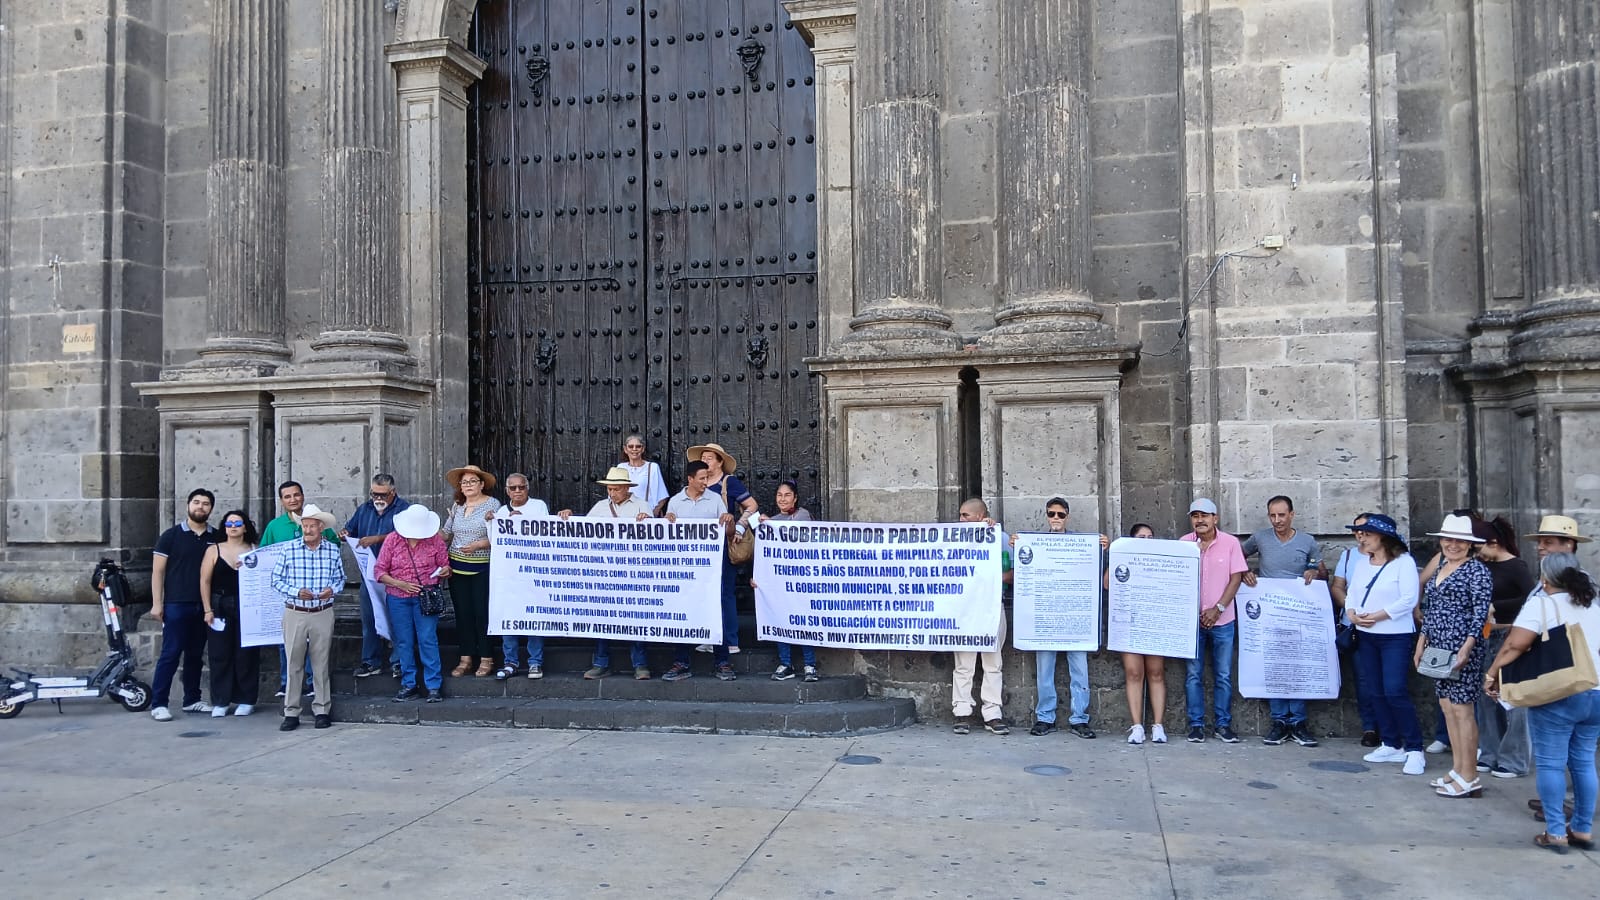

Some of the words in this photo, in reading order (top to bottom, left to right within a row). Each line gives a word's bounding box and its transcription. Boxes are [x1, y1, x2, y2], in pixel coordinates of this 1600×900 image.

[498, 519, 518, 535] SR.
[521, 520, 614, 539] GOBERNADOR
[619, 523, 664, 540] PABLO
[669, 523, 718, 540] LEMUS
[758, 524, 778, 542] SR.
[780, 525, 884, 544] GOBERNADOR
[889, 527, 938, 544] PABLO
[943, 527, 996, 544] LEMUS
[504, 539, 541, 548] SOLICITAMOS
[541, 540, 550, 548] LEA
[557, 541, 580, 550] ANALICE
[581, 542, 588, 550] LO
[591, 543, 629, 551] INCUMPLIBLE
[633, 544, 643, 552] DEL
[644, 544, 676, 552] CONVENIO
[678, 544, 689, 552] QUE
[514, 552, 549, 561] REGULARIZAR
[553, 554, 578, 563] NUESTRA
[606, 556, 613, 564] YA
[615, 557, 627, 565] QUE
[628, 557, 640, 565] NOS
[641, 558, 671, 566] CONDENA
[672, 558, 680, 566] DE
[681, 558, 694, 566] POR
[695, 558, 710, 566] VIDA
[763, 547, 771, 557] EN
[773, 548, 782, 558] LA
[784, 549, 819, 560] COLONIA
[822, 549, 830, 560] EL
[833, 549, 877, 561] PEDREGAL
[882, 550, 894, 560] DE
[896, 549, 945, 561] MILPILLAS,
[947, 549, 989, 561] ZAPOPAN
[533, 567, 549, 575] TENER
[551, 567, 581, 576] SERVICIOS
[609, 570, 627, 578] COMO
[638, 571, 654, 579] AGUA
[773, 565, 811, 577] TENEMOS
[813, 566, 819, 577] 5
[822, 564, 845, 577] AÑOS
[848, 566, 907, 579] BATALLANDO,
[909, 567, 928, 577] POR
[931, 567, 940, 577] EL
[942, 566, 967, 577] AGUA
[969, 566, 975, 577] Y
[542, 580, 552, 588] QUE
[562, 581, 583, 589] SOMOS
[594, 583, 650, 592] FRACCIONAMIENTO
[653, 585, 679, 593] PRIVADO
[786, 581, 794, 592] EL
[796, 582, 840, 593] GOBIERNO
[898, 584, 910, 594] SE
[912, 584, 924, 594] HA
[927, 584, 963, 594] NEGADO
[561, 595, 588, 603] INMENSA
[638, 598, 663, 606] VECINOS
[810, 599, 882, 611] ROTUNDAMENTE
[885, 601, 891, 611] A
[893, 601, 934, 612] CUMPLIR
[536, 606, 562, 615] TENEMOS
[572, 608, 609, 617] POSIBILIDAD
[619, 610, 654, 619] CONTRIBUIR
[656, 612, 672, 620] PARA
[502, 620, 512, 630] LE
[513, 620, 569, 632] SOLICITAMOS
[573, 623, 591, 633] MUY
[593, 623, 648, 636] ATENTAMENTE
[650, 626, 661, 636] SU
[663, 626, 710, 638] ANULACIÓN
[789, 615, 805, 626] CON
[808, 616, 820, 626] SU
[822, 615, 875, 628] OBLIGACIÓN
[878, 618, 960, 630] CONSTITUCIONAL.
[763, 625, 771, 635] LE
[772, 627, 823, 642] SOLICITAMOS
[828, 633, 847, 643] MUY
[849, 634, 910, 645] ATENTAMENTE
[912, 635, 924, 645] SU
[929, 634, 996, 647] INTERVENCIÓN
